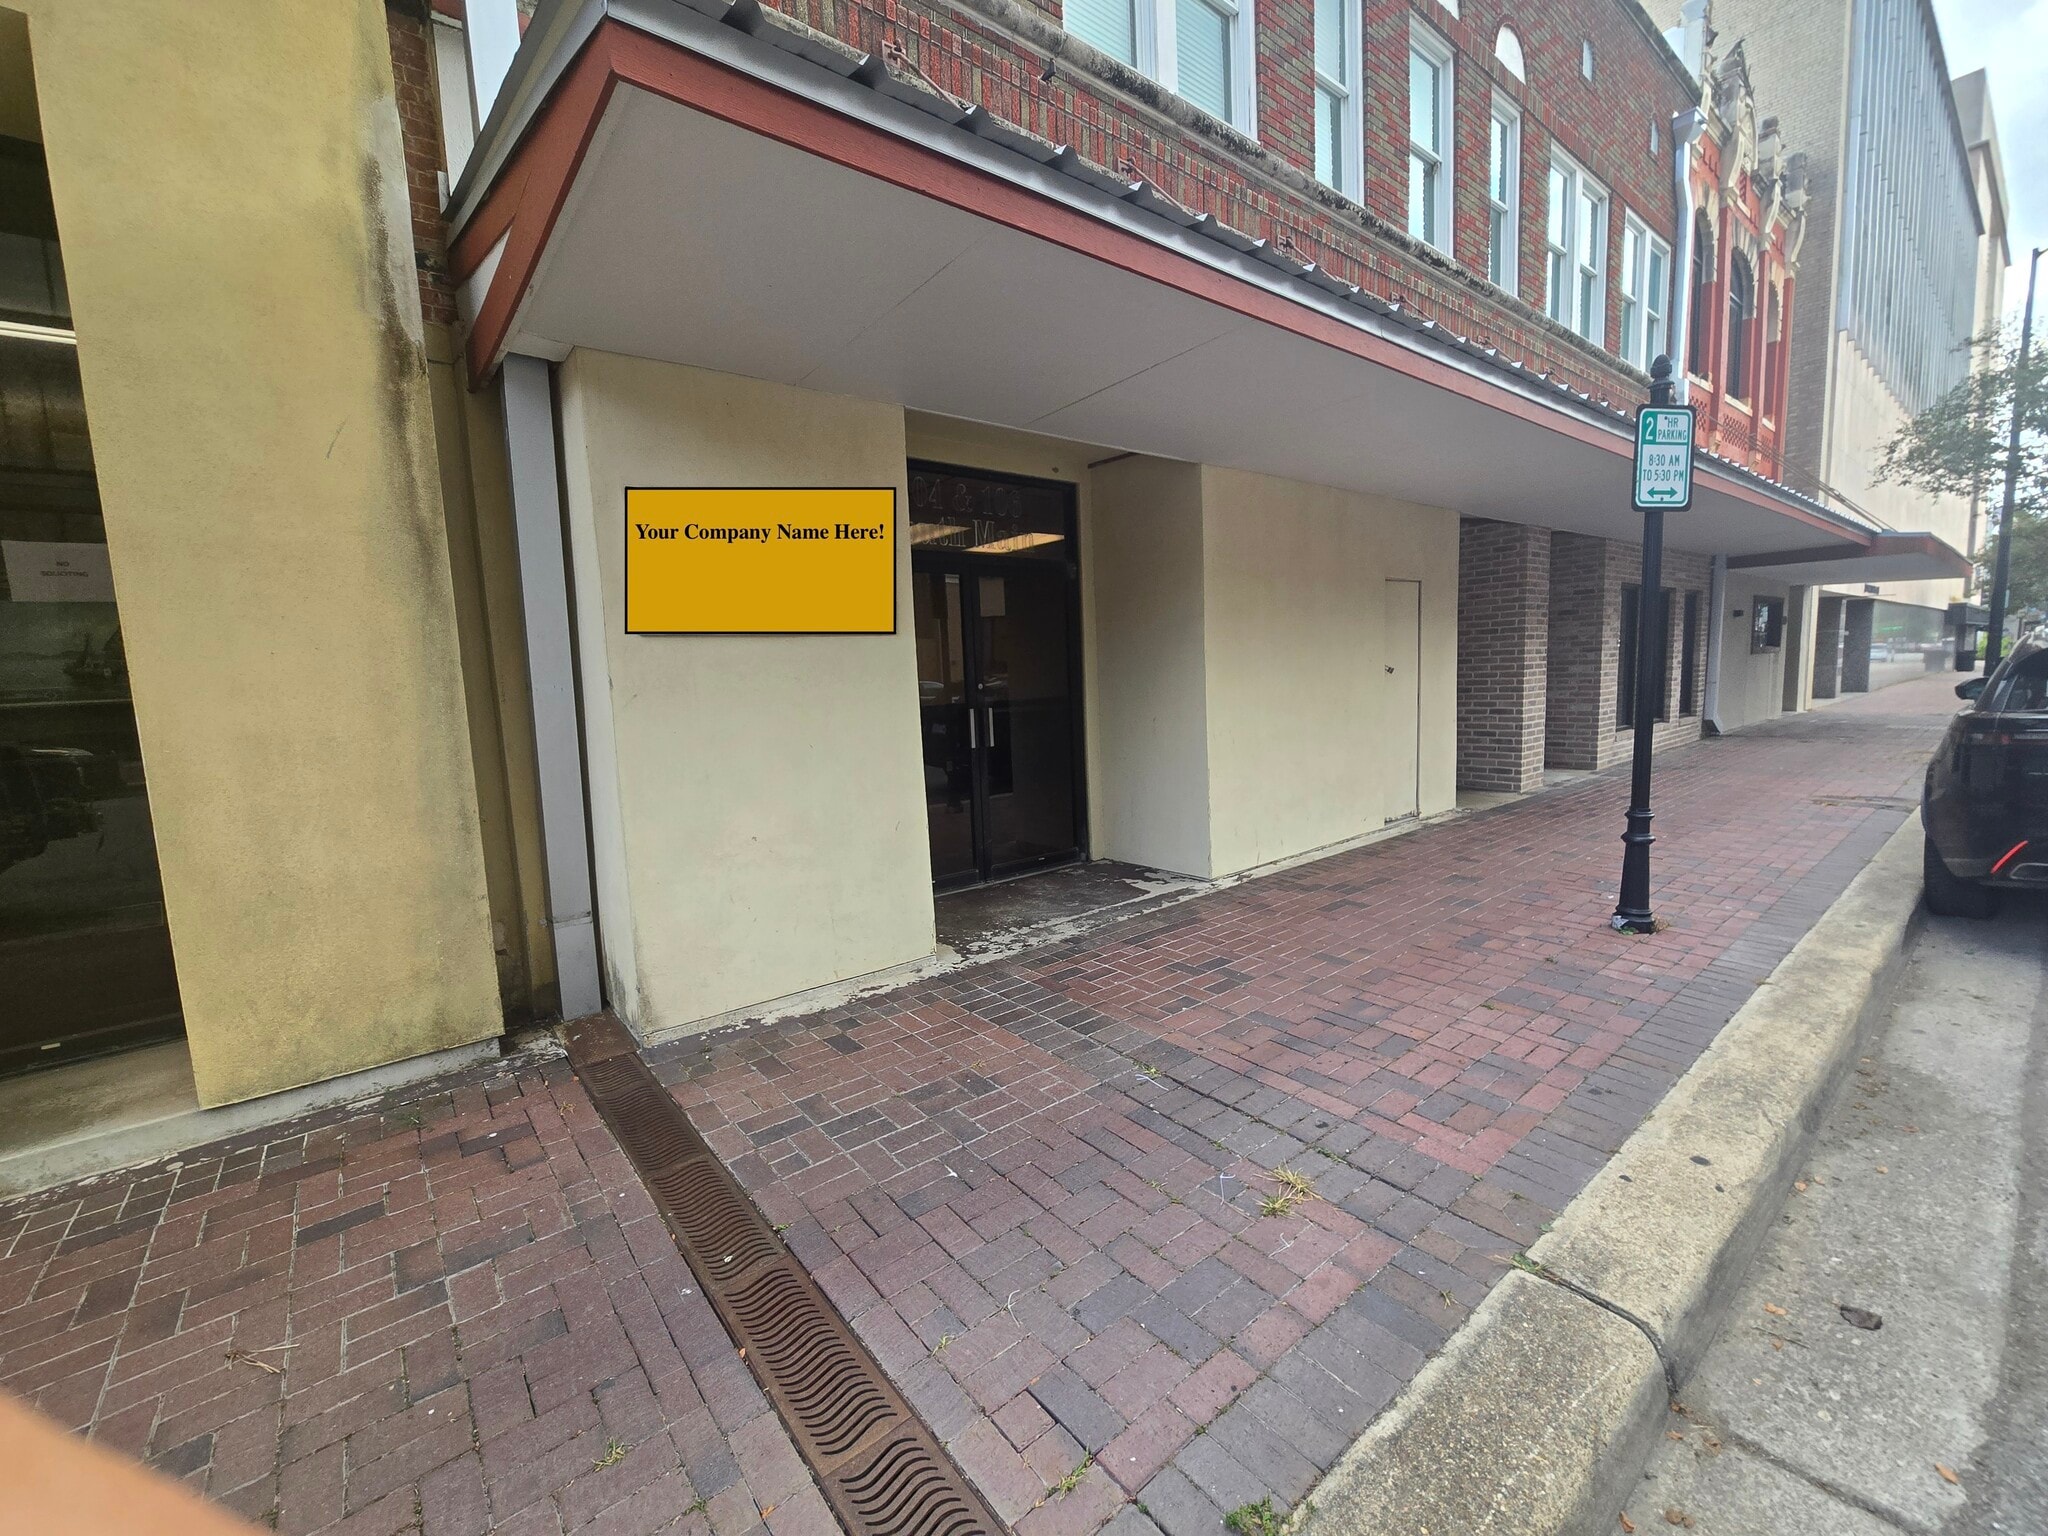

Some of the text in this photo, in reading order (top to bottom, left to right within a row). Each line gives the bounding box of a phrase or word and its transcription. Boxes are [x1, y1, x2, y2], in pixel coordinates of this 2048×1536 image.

[1645, 416, 1679, 440] 2 HR
[1657, 429, 1687, 440] PARKING
[1648, 454, 1680, 466] 8:30 AM
[1643, 469, 1684, 481] TO 5:30 PM
[635, 523, 885, 544] Your Company Name Here!
